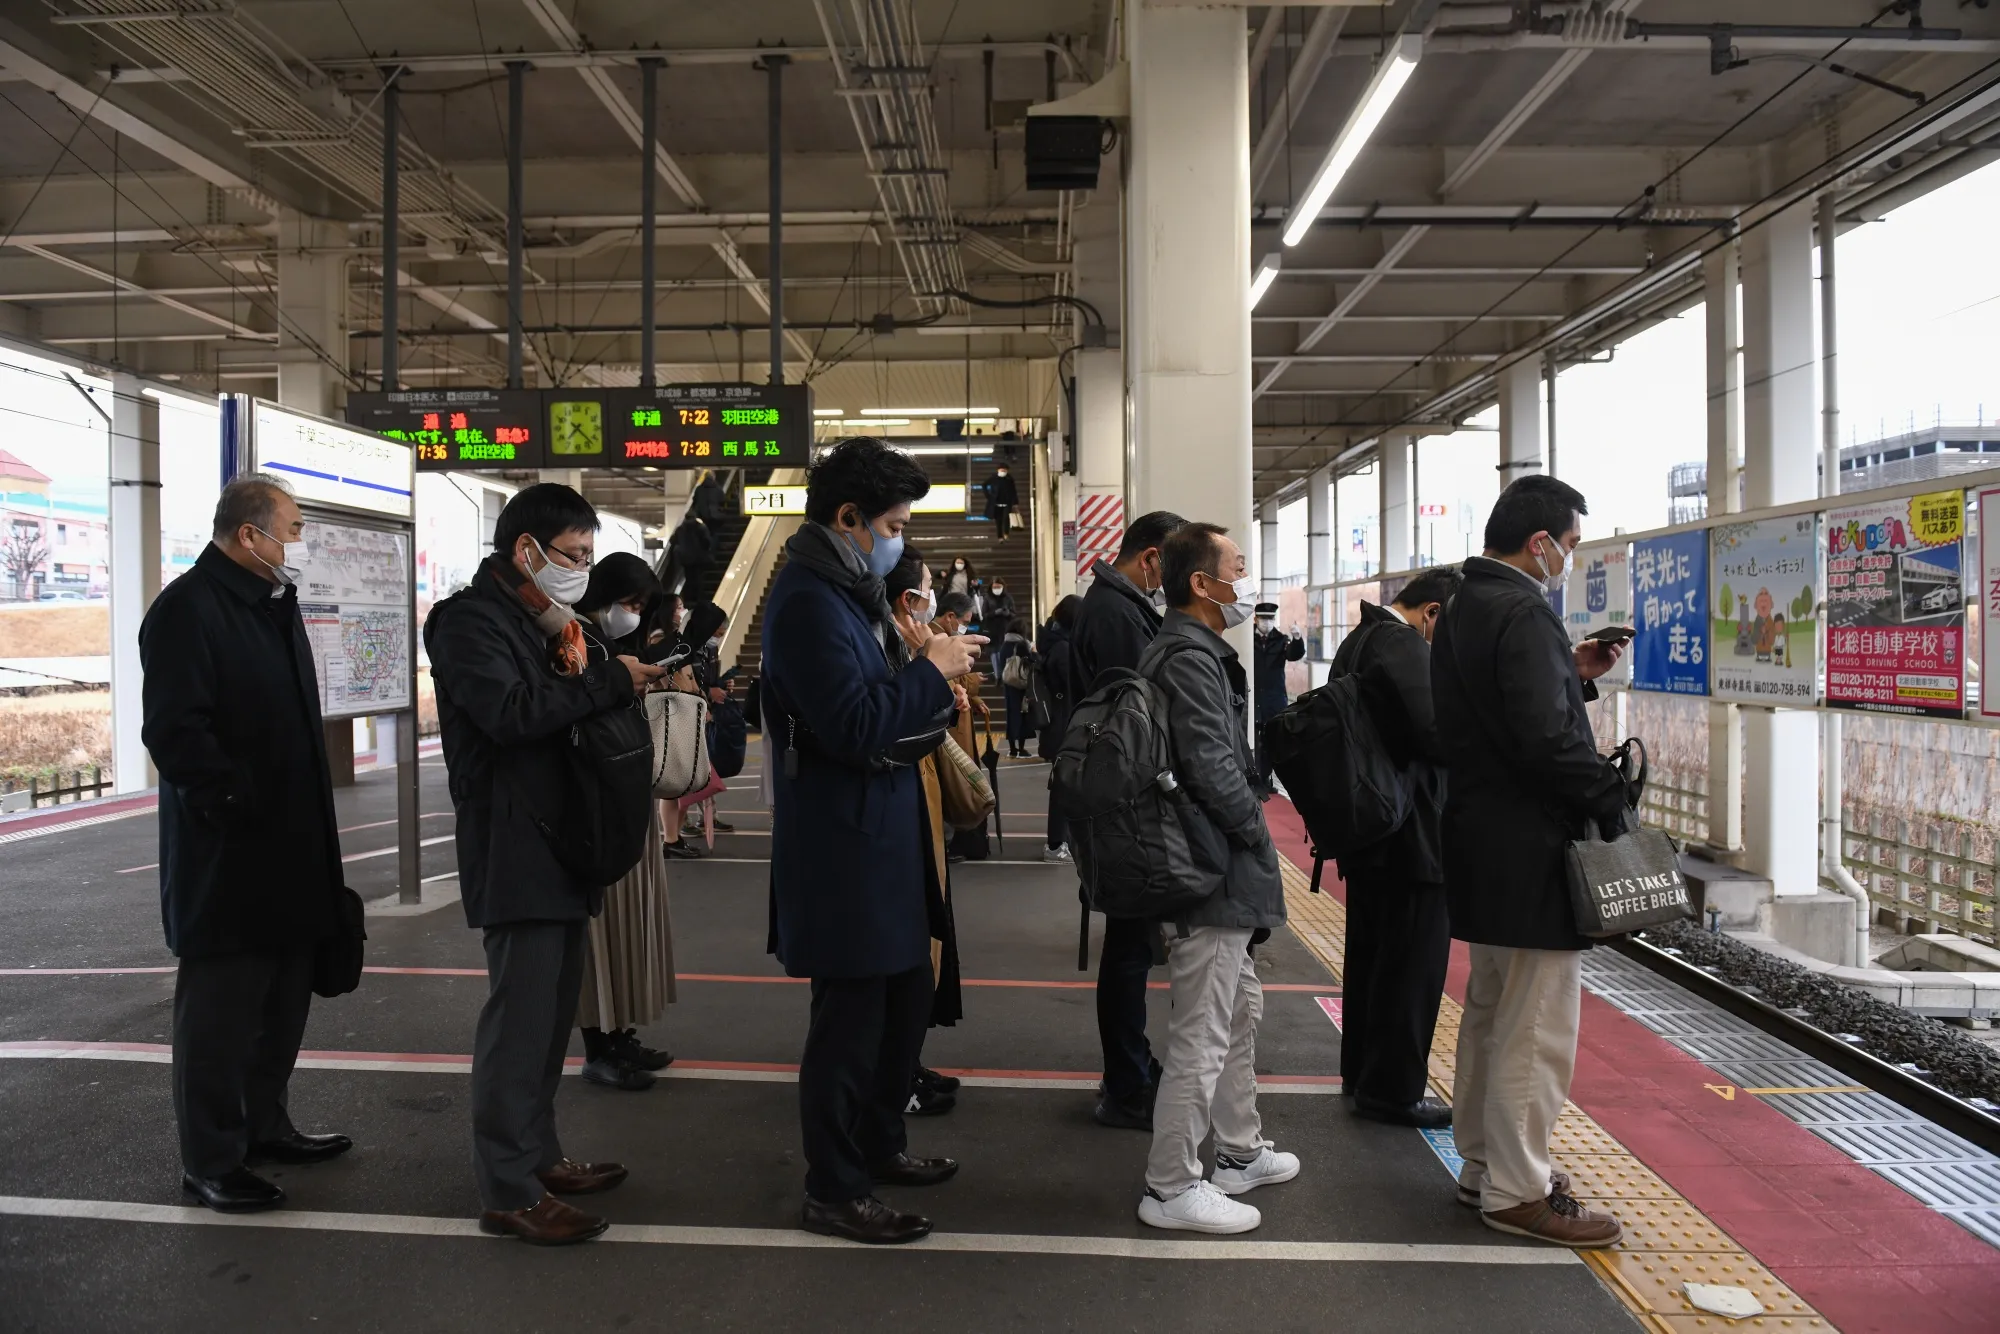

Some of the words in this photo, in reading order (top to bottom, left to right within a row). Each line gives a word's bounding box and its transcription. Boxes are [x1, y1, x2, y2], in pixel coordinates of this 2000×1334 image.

[632, 410, 662, 426] 普通
[679, 409, 709, 425] 7:22
[721, 409, 779, 425] 羽田空港
[418, 445, 447, 460] 7:36
[459, 444, 515, 460] 成田空港
[680, 441, 710, 456] 7:28
[722, 440, 780, 457] 西馬込
[1921, 506, 1959, 523] 無料送迎
[1829, 516, 1907, 555] HOKUDORA
[1922, 521, 1957, 535] バスあり
[1636, 547, 1691, 593] 栄光に
[1643, 588, 1697, 632] 向かって
[1668, 622, 1703, 665] 走る
[1831, 631, 1938, 656] 北総自動車学校
[1830, 657, 1860, 666] HOKUSO
[1866, 658, 1898, 667] DRIVING
[1904, 659, 1938, 669] SCHOOL
[1761, 681, 1811, 696] 0120-758-594
[1840, 673, 1894, 687] 0120-171-211
[1830, 686, 1894, 700] TEL.0476-98-1211
[1598, 878, 1636, 899] LET'S
[1636, 873, 1671, 891] TAKE
[1671, 870, 1681, 884] A
[1600, 896, 1649, 919] COFFEE
[1650, 888, 1689, 909] BREAK
